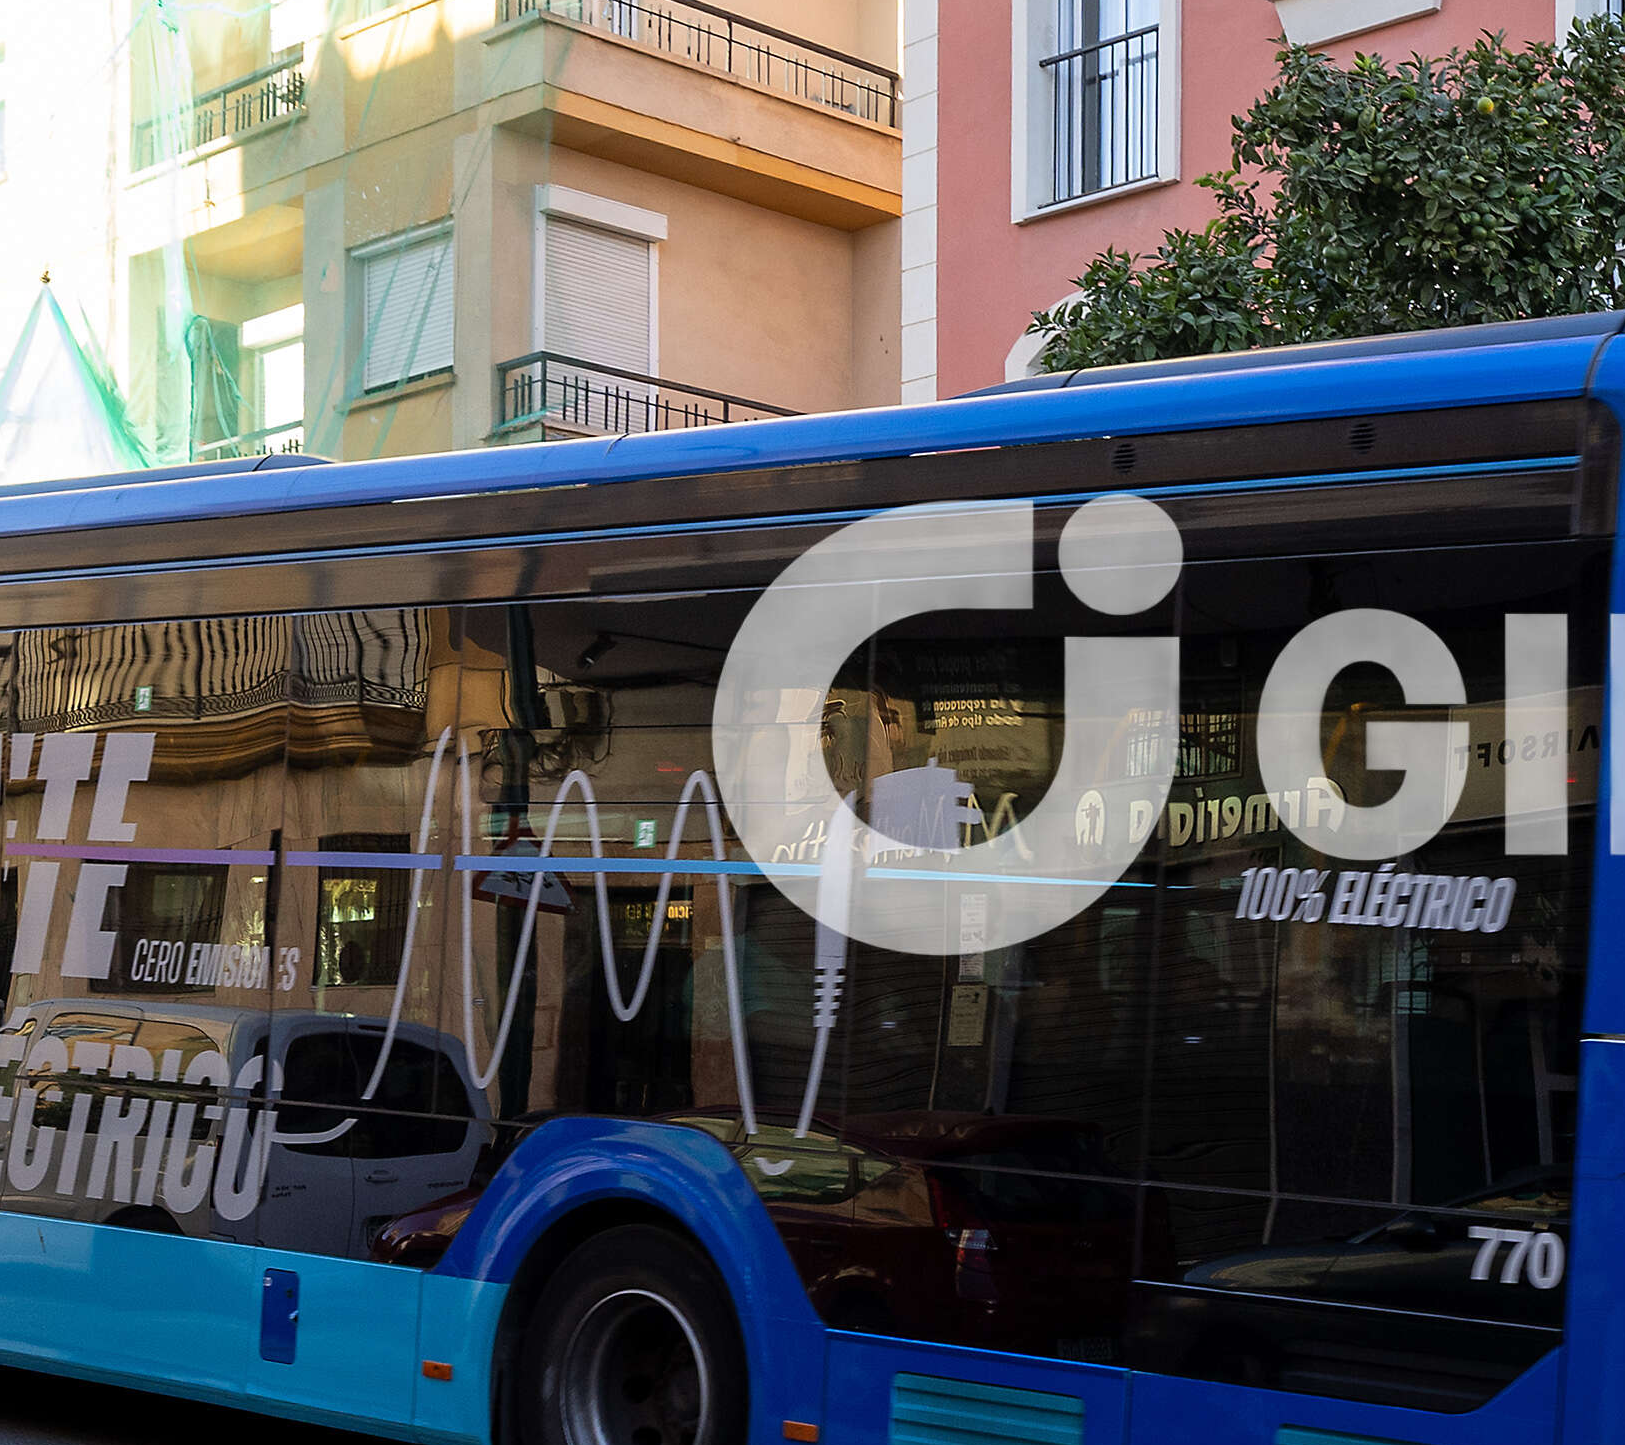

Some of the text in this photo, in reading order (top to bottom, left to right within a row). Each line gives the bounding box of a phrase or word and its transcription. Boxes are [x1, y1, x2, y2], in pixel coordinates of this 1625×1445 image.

[1235, 862, 1517, 933] 100% ELÉCTRICO
[130, 937, 185, 985] CERO
[1468, 1225, 1565, 1289] 770
